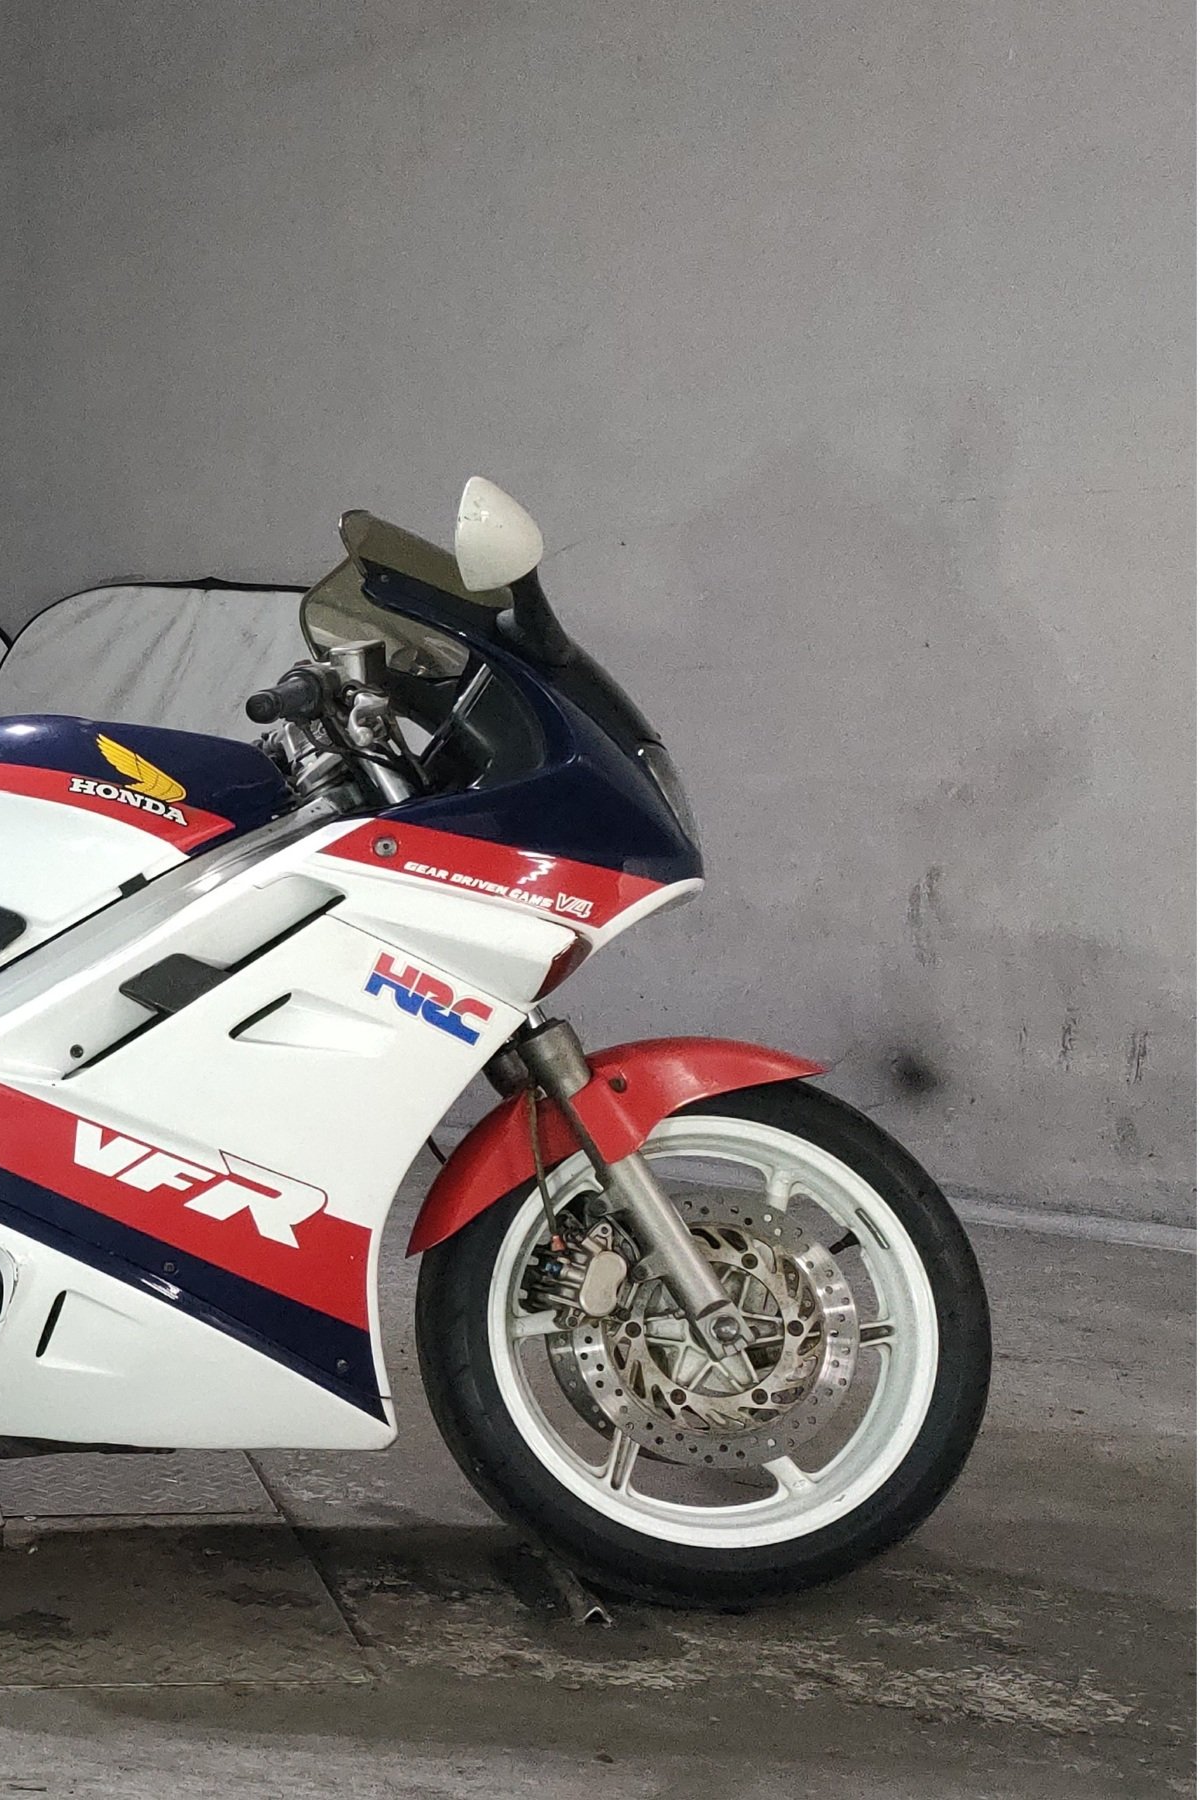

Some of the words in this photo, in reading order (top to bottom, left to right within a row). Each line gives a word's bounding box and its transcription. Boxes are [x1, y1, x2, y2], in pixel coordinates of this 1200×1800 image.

[70, 778, 188, 826] HONDA
[404, 861, 448, 880] GEAR
[450, 873, 508, 897] DRIVEN
[555, 892, 594, 918] V4
[364, 952, 493, 1046] HRC
[73, 1119, 328, 1249] VFR
